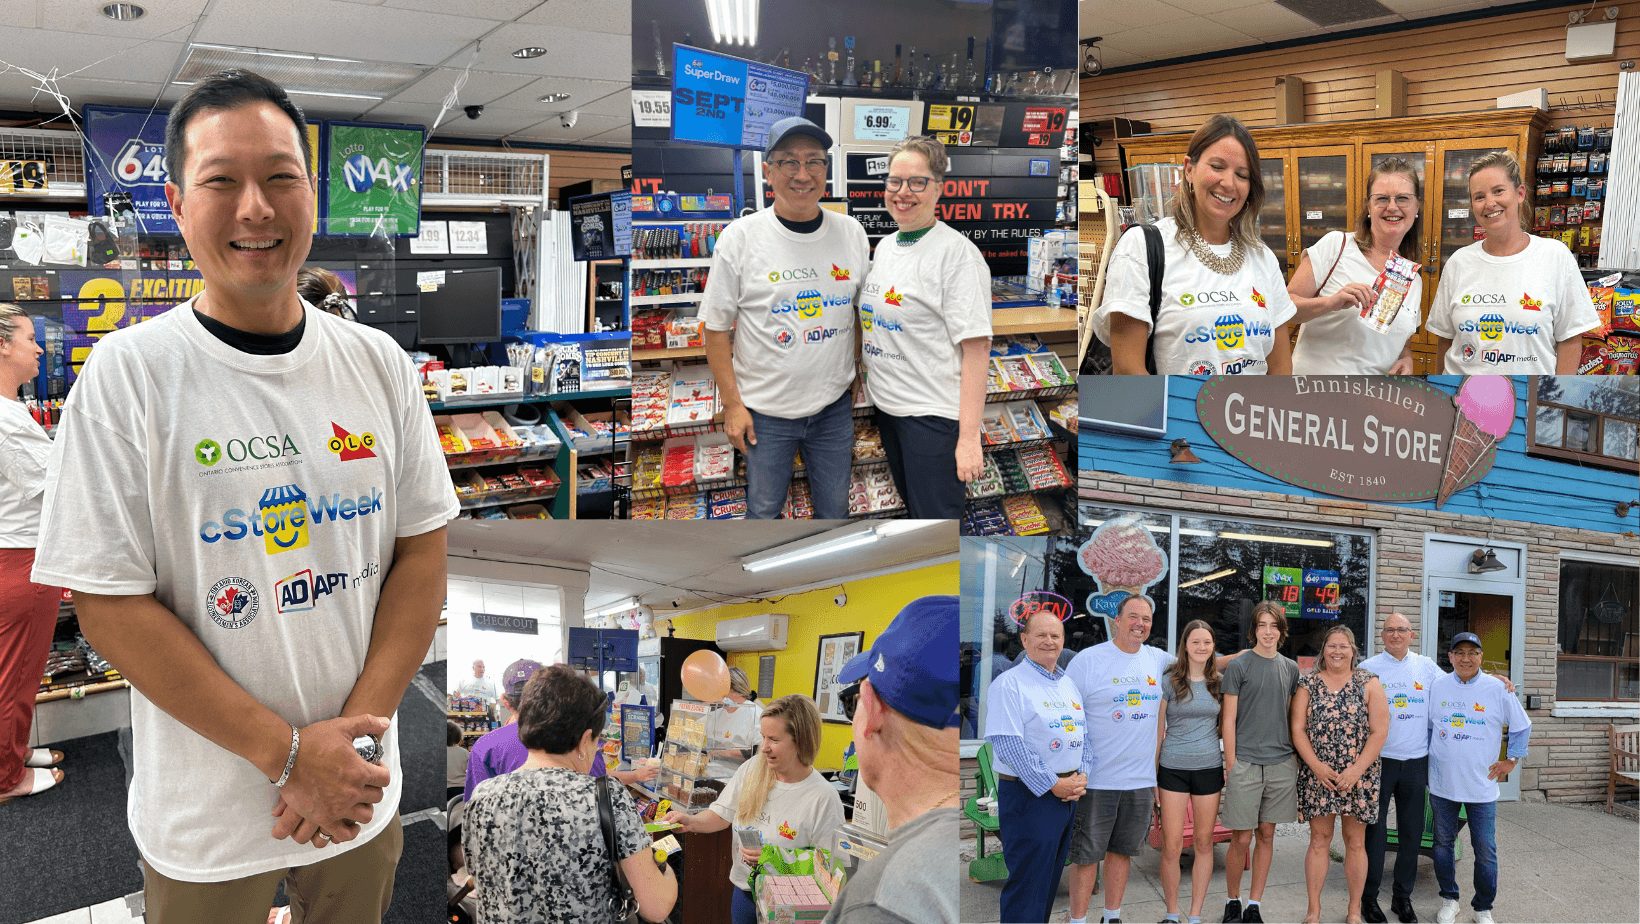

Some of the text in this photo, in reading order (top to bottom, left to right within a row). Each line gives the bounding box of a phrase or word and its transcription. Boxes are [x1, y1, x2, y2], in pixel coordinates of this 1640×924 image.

[749, 79, 767, 93] 649
[675, 87, 745, 113] SEPT
[695, 106, 726, 119] 2ND
[949, 107, 973, 130] 19
[1046, 112, 1065, 130] 19
[948, 134, 957, 144] 19
[339, 144, 364, 158] Lotto
[343, 155, 411, 193] MAX
[943, 180, 990, 198] ON'T
[863, 214, 882, 222] PLAY
[992, 203, 1031, 219] TRY.
[862, 221, 876, 229] THE
[960, 229, 972, 239] AY
[974, 229, 988, 239] BY
[990, 229, 1009, 239] THE
[782, 268, 818, 280] OCSA
[130, 278, 205, 305] EXCITIN
[1197, 290, 1240, 304] OCSA
[1472, 293, 1507, 304] OCSA
[1458, 319, 1541, 335] cStoreWeek
[1577, 356, 1603, 375] wizzlers
[1292, 375, 1426, 417] Enniskillen
[1224, 392, 1443, 465] GENERAL STORE
[226, 434, 302, 463] OCSA
[329, 434, 374, 451] OLG
[198, 468, 223, 477] ONTARIO
[224, 465, 259, 474] CONVENIENCE
[1330, 468, 1386, 486] EST 1840
[199, 486, 383, 544] cStoreWeek
[1282, 585, 1300, 602] 18
[1095, 598, 1119, 610] Kaw
[475, 615, 534, 629] CHECK OUT
[855, 800, 867, 811] 500
